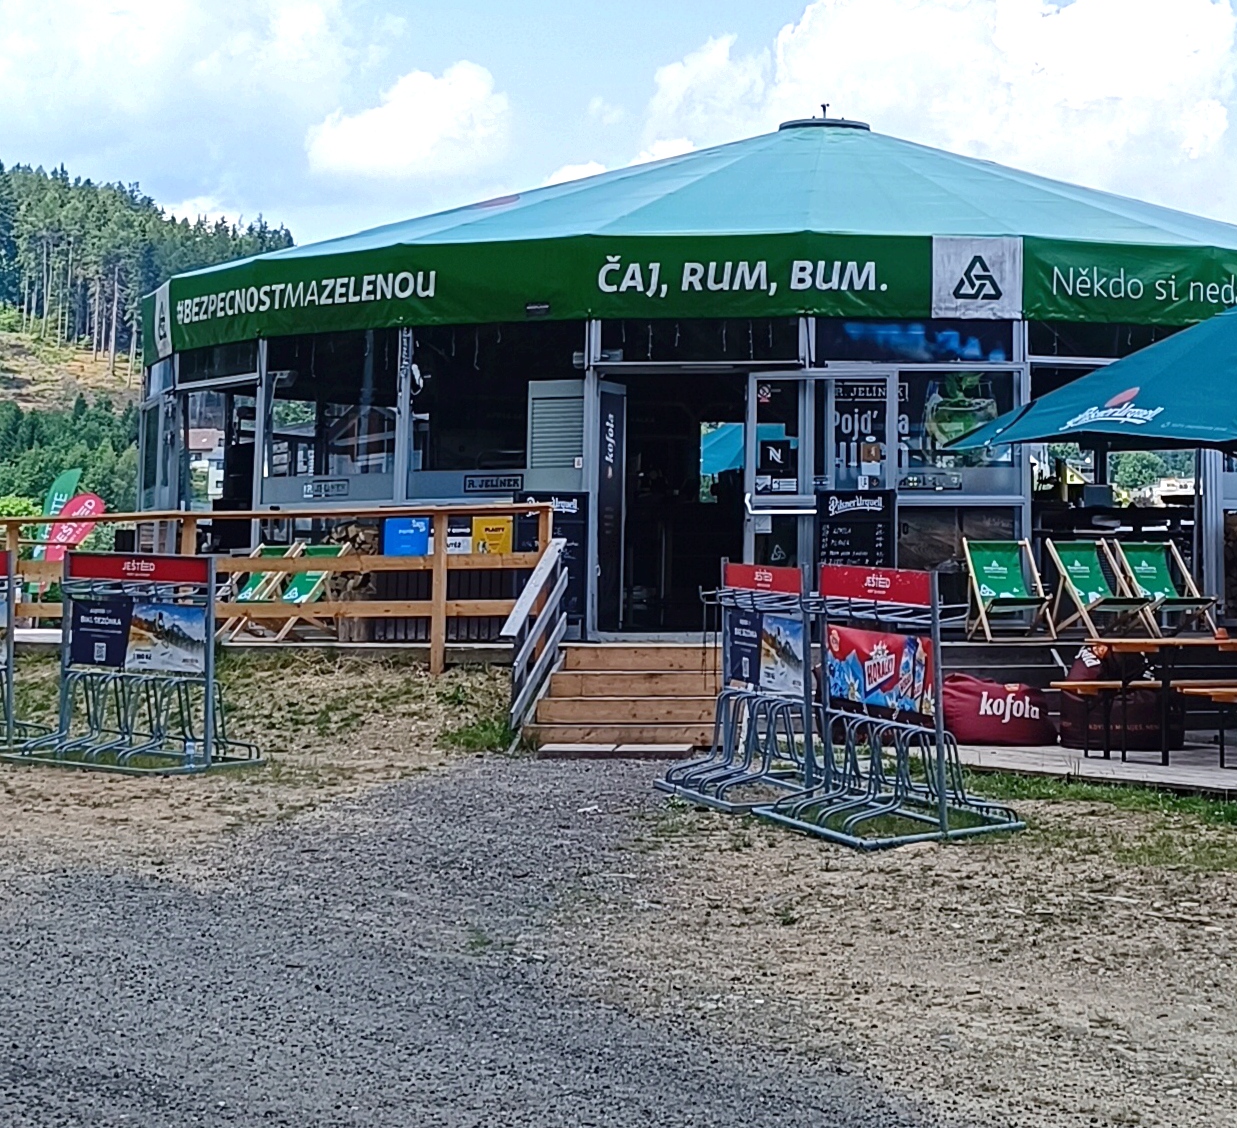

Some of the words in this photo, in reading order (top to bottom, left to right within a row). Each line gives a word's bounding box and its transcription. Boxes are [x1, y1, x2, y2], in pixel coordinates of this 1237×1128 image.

[598, 255, 668, 298] ČAJ,
[681, 260, 777, 296] RUM,
[790, 260, 888, 291] BUM.
[1052, 266, 1144, 300] Někdo
[1155, 275, 1179, 302] si
[176, 270, 437, 325] #BEZPECNOSTMAZELENOU
[850, 385, 904, 397] JELÍNK
[479, 477, 520, 488] JELÍNEK
[979, 691, 1040, 724] kofola
